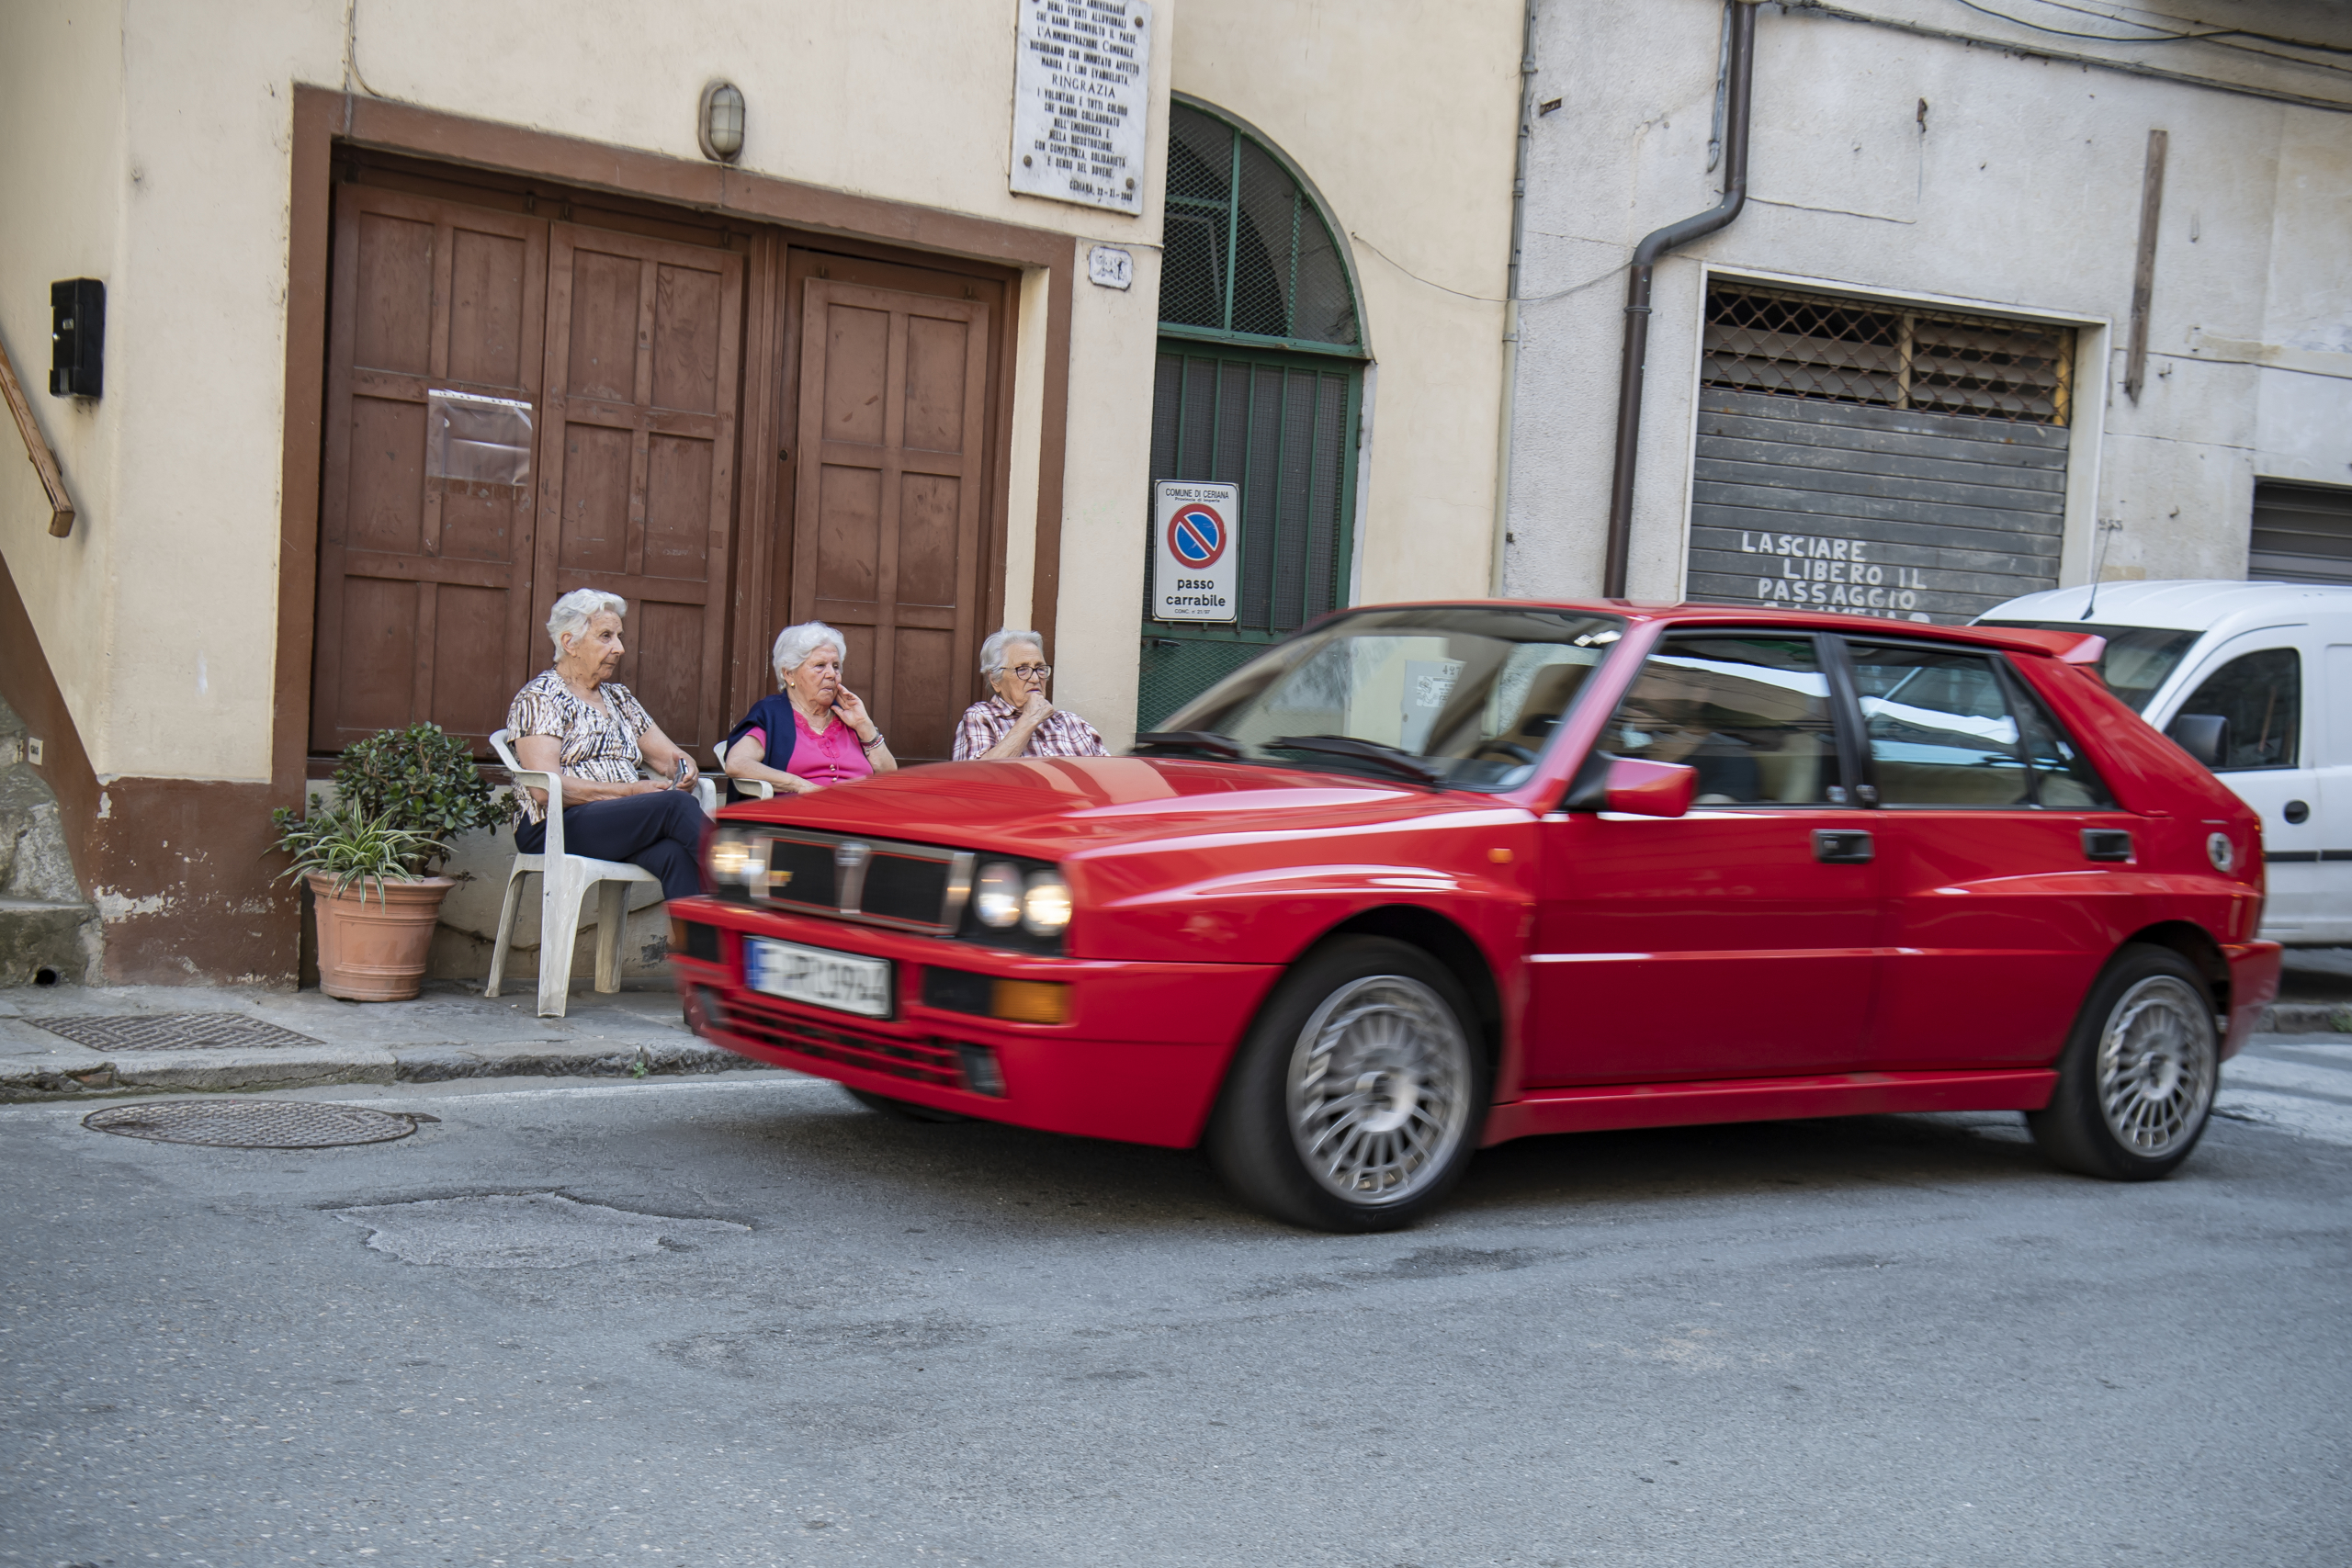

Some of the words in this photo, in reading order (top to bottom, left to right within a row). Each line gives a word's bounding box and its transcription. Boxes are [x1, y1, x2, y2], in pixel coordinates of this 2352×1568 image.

[1036, 10, 1046, 22] CHE
[1052, 15, 1069, 28] HANNO
[1074, 20, 1105, 37] SCONVOLTO
[1110, 28, 1114, 39] IL
[1047, 1, 1063, 13] DEGLI
[1068, 6, 1087, 18] EVENTI
[1091, 11, 1126, 28] ALLUVIONALI
[1041, 55, 1062, 70] MARISA
[1067, 62, 1070, 73] E
[1075, 64, 1087, 75] LINO
[1069, 49, 1080, 61] CON
[1084, 52, 1112, 68] IMMUTATO
[1115, 60, 1140, 76] AFFETTO
[1052, 73, 1115, 99] RINGRAZIA
[1045, 88, 1075, 105] VOLONTARI
[1088, 97, 1103, 110] TUTTI
[1107, 102, 1128, 117] COLORO
[1045, 102, 1055, 113] CHE
[1059, 105, 1078, 118] HANNO
[1081, 109, 1120, 128] COLLABORATO
[1035, 139, 1046, 151] CON
[1048, 129, 1067, 142] NELLA
[1106, 128, 1110, 139] E
[1047, 155, 1051, 166] E
[1056, 157, 1072, 170] SENSO
[1078, 162, 1087, 174] DEL
[1165, 488, 1193, 497] COMUNE
[1204, 490, 1229, 499] CERIANA
[1741, 531, 1867, 562] LASCIARE
[1177, 579, 1214, 591] passo
[1783, 558, 1883, 585] LIBERO
[1899, 568, 1927, 590] IL
[1166, 594, 1226, 606] carrabile
[1758, 578, 1916, 610] PASSAGGIO
